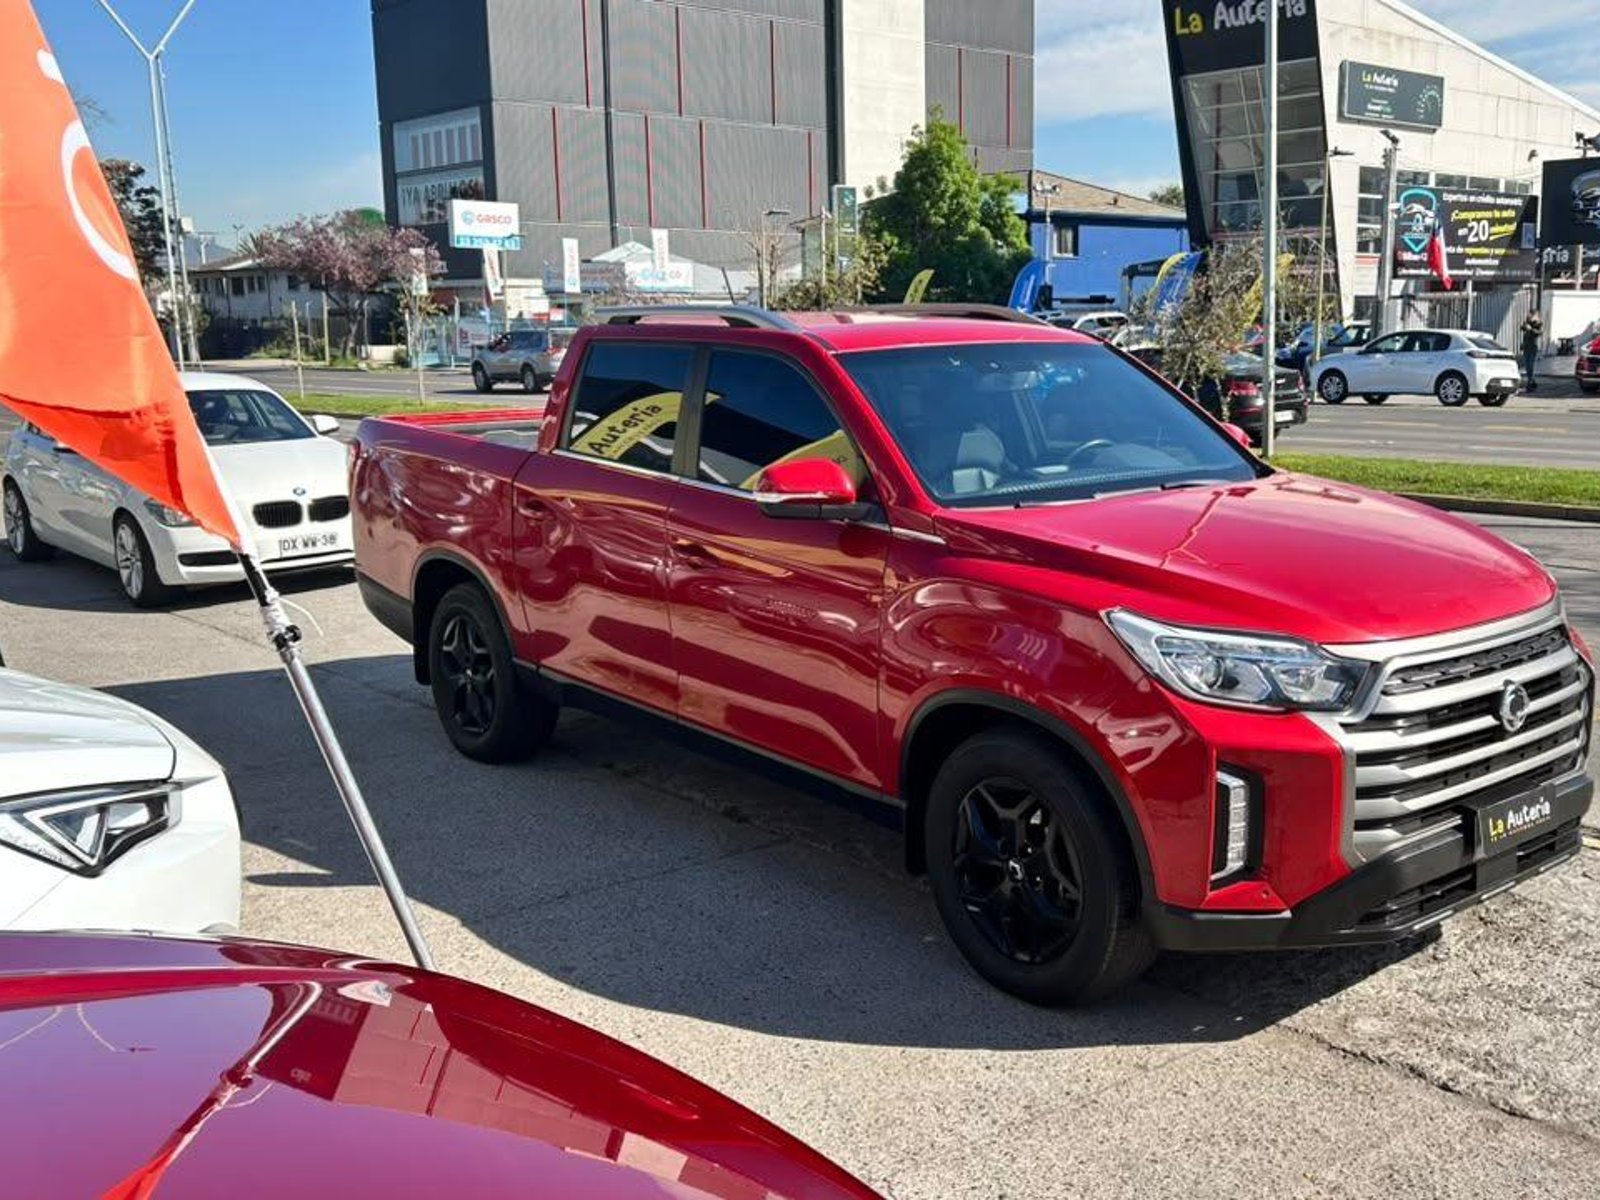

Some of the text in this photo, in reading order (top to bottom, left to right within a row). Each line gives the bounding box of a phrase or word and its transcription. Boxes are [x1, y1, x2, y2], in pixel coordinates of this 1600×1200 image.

[1174, 8, 1203, 35] La
[1468, 220, 1489, 243] 20
[1489, 818, 1504, 837] La
